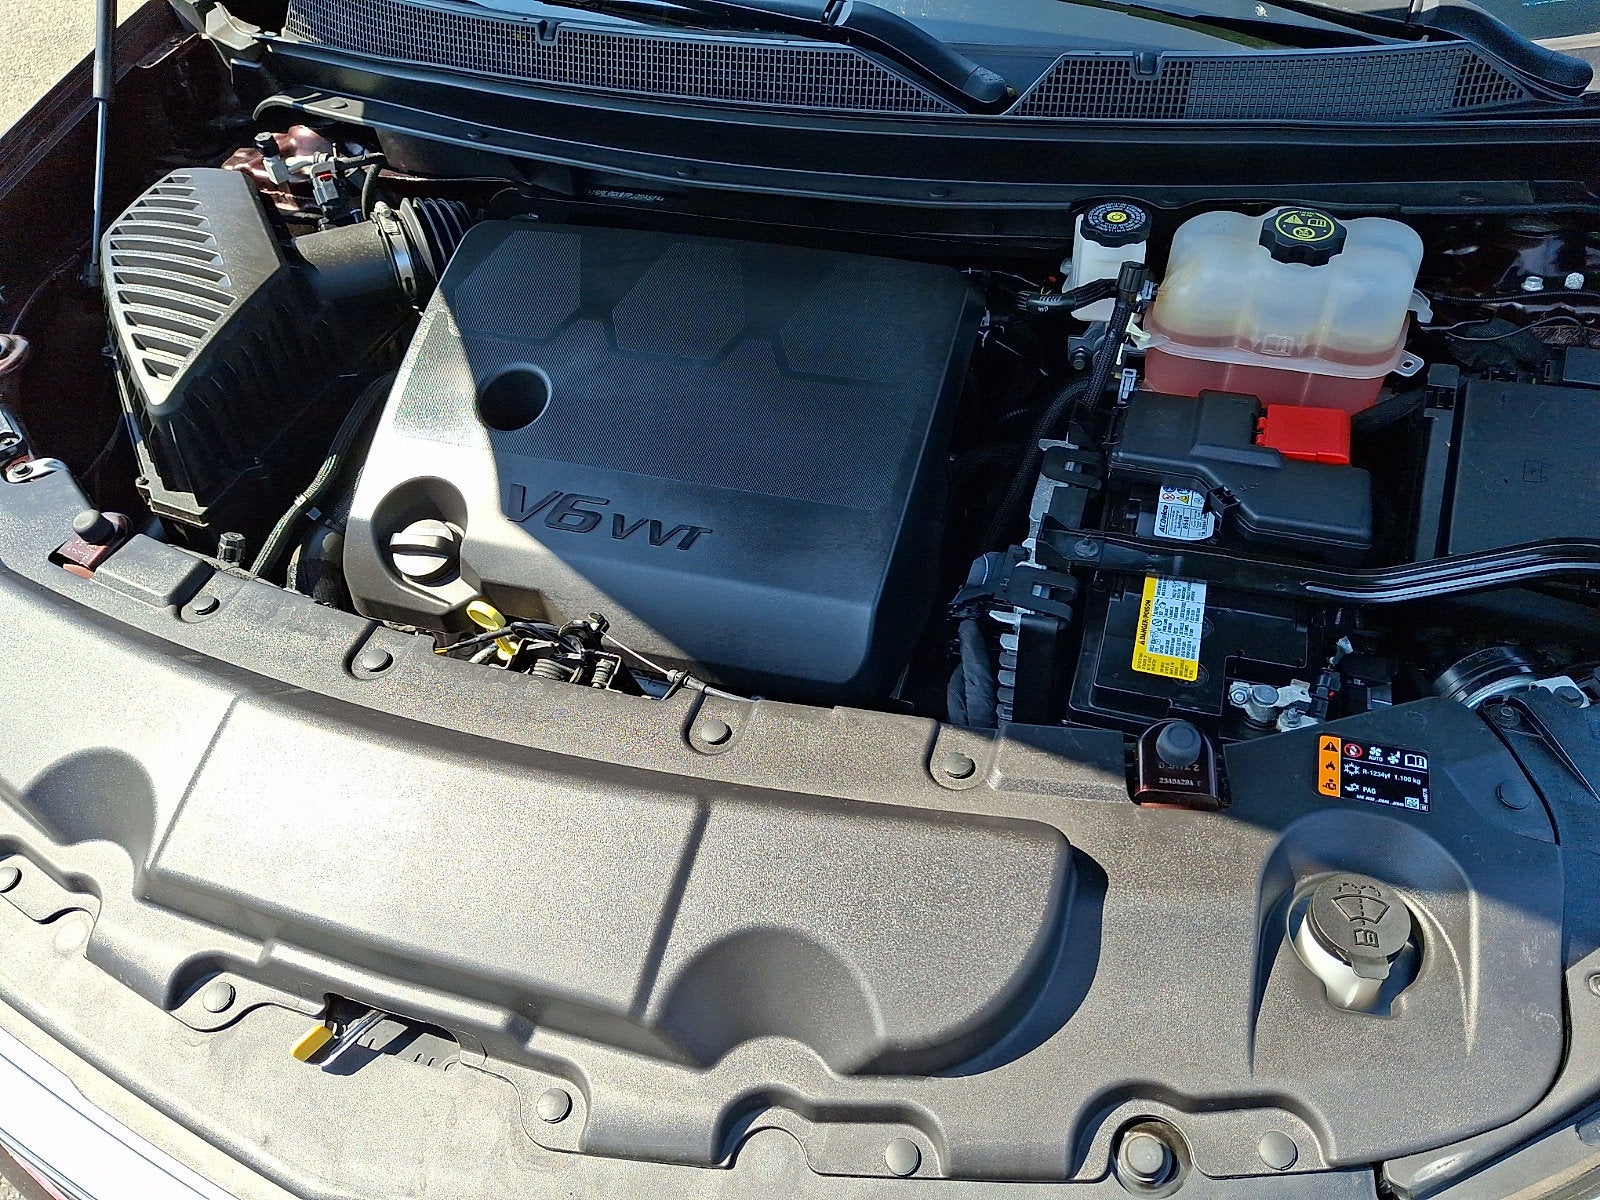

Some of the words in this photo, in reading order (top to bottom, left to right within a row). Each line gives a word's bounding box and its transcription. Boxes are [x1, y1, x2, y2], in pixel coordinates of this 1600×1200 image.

[507, 483, 610, 533] V6
[611, 513, 713, 551] VVT
[1362, 769, 1390, 779] R-1234yf
[1394, 774, 1411, 783] 1.100
[1412, 776, 1421, 786] kg
